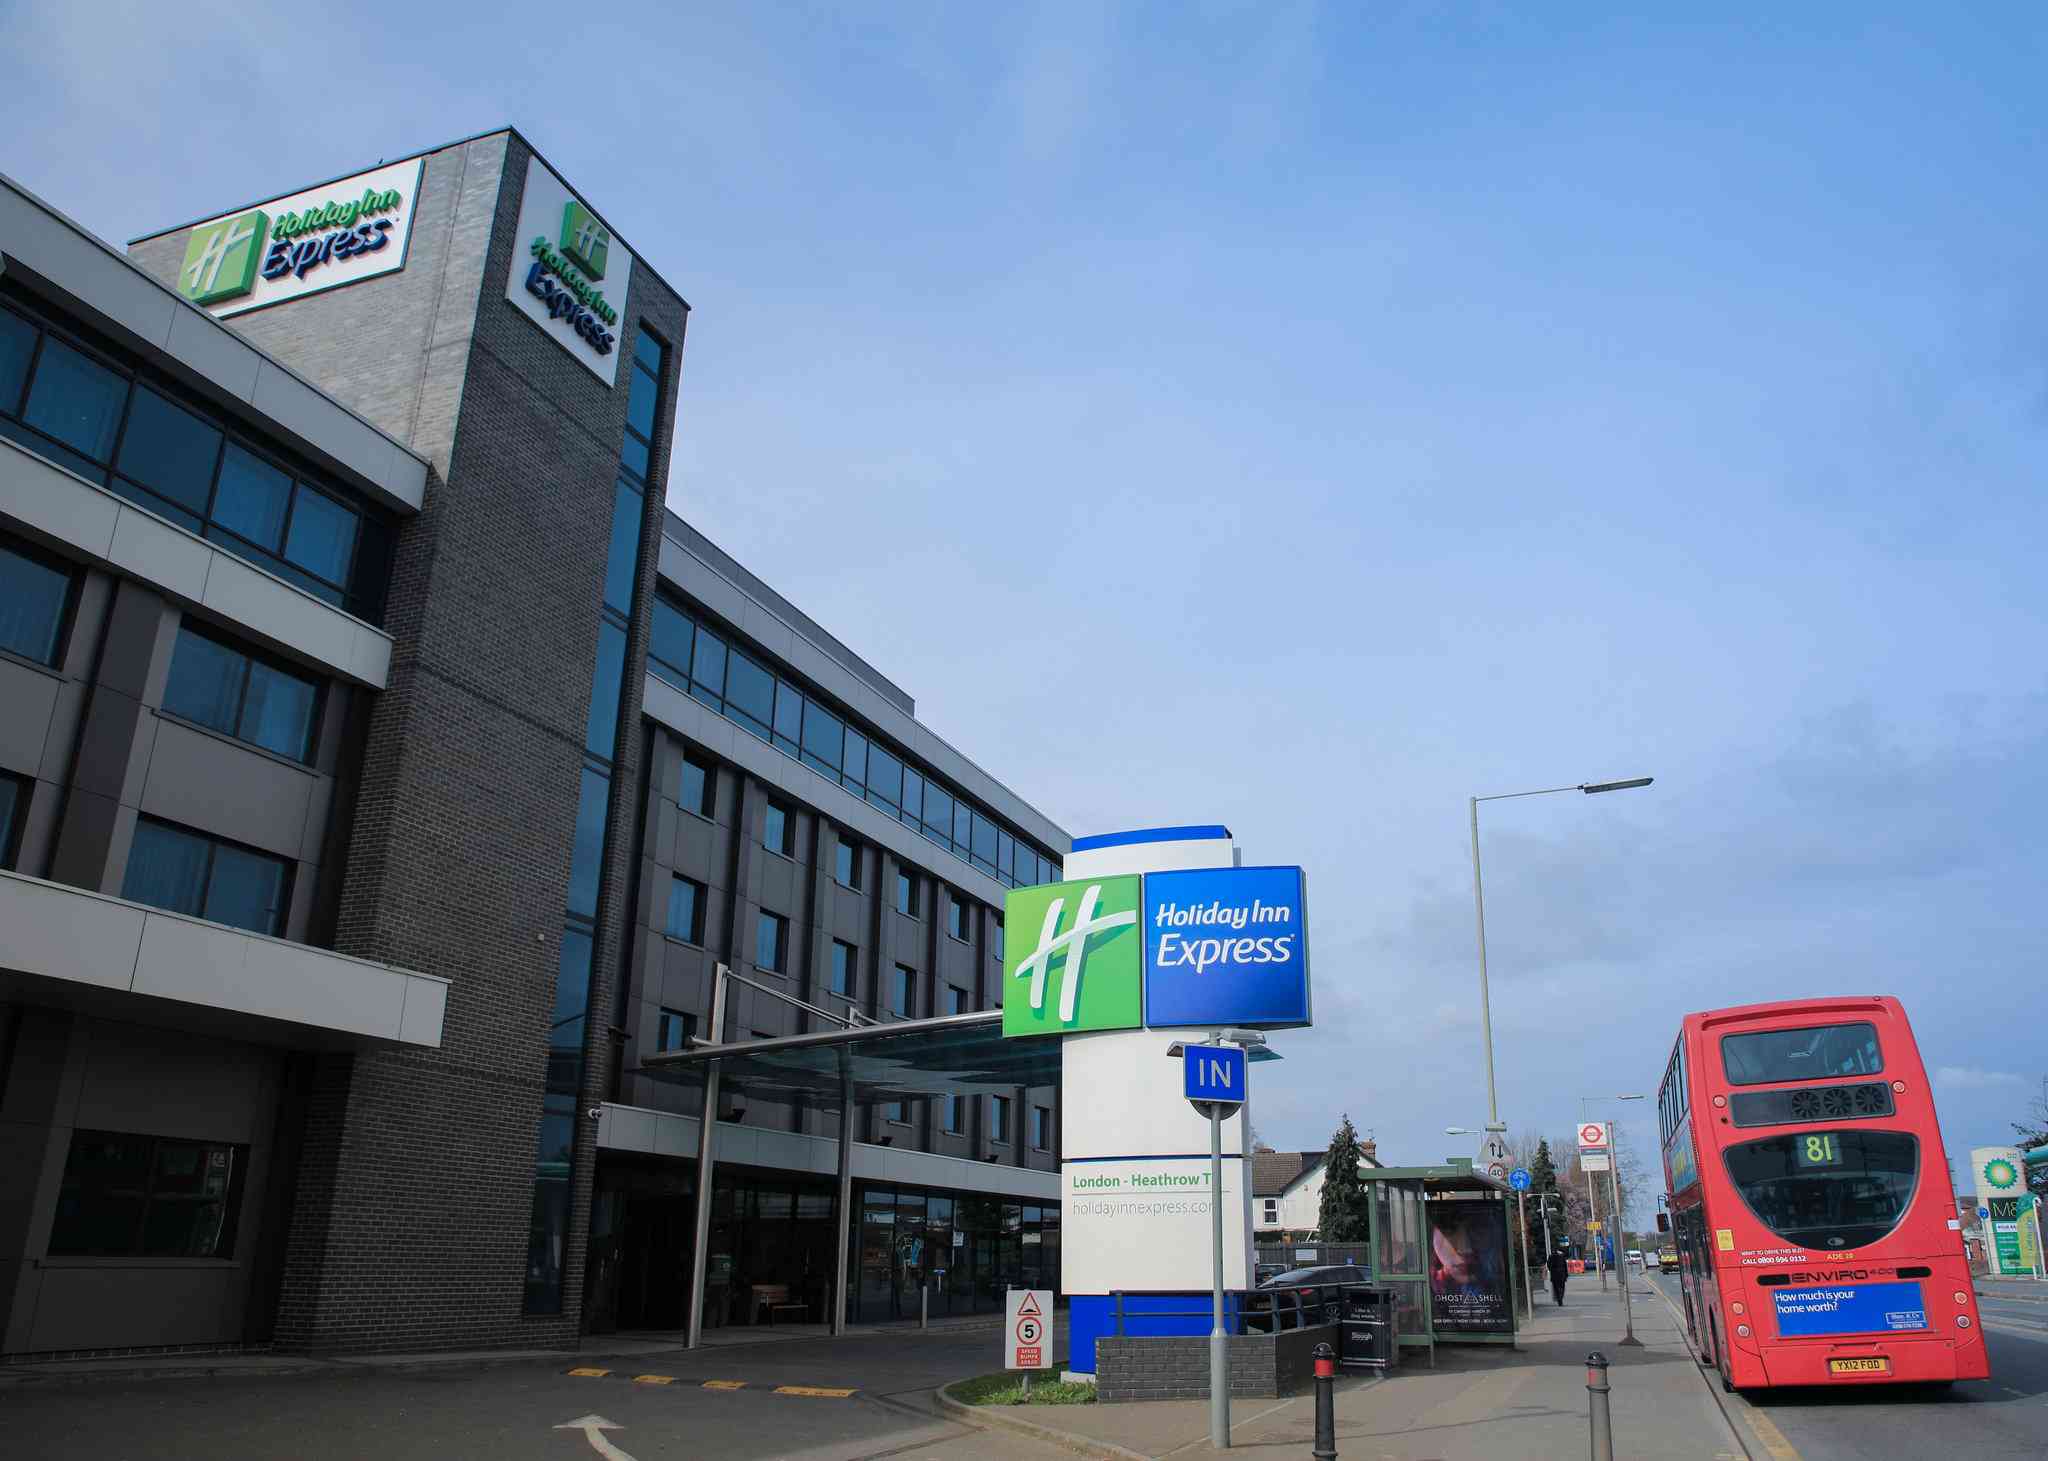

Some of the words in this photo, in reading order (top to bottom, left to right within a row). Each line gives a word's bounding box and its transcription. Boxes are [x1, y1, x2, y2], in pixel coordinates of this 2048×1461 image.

[271, 200, 360, 240] Holiday
[358, 188, 401, 216] Inn
[260, 218, 392, 280] Express
[525, 262, 616, 355] Express
[1155, 901, 1248, 929] Holiday
[1251, 899, 1291, 923] Inn
[1156, 933, 1292, 974] Express
[1199, 1058, 1231, 1088] IN
[1806, 1135, 1832, 1162] 81
[1073, 1175, 1120, 1188] London
[1131, 1173, 1200, 1187] Heathrow
[1202, 1173, 1212, 1185] T
[1491, 1169, 1502, 1177] 40
[1792, 1270, 1868, 1282] ENVIRO
[1775, 1292, 1796, 1302] How
[1798, 1290, 1824, 1301] much
[1825, 1290, 1833, 1300] is
[1833, 1290, 1855, 1302] your
[1777, 1304, 1805, 1314] home
[1806, 1301, 1838, 1312] worth?
[1024, 1324, 1034, 1338] 5
[1837, 1360, 1858, 1370] YX12
